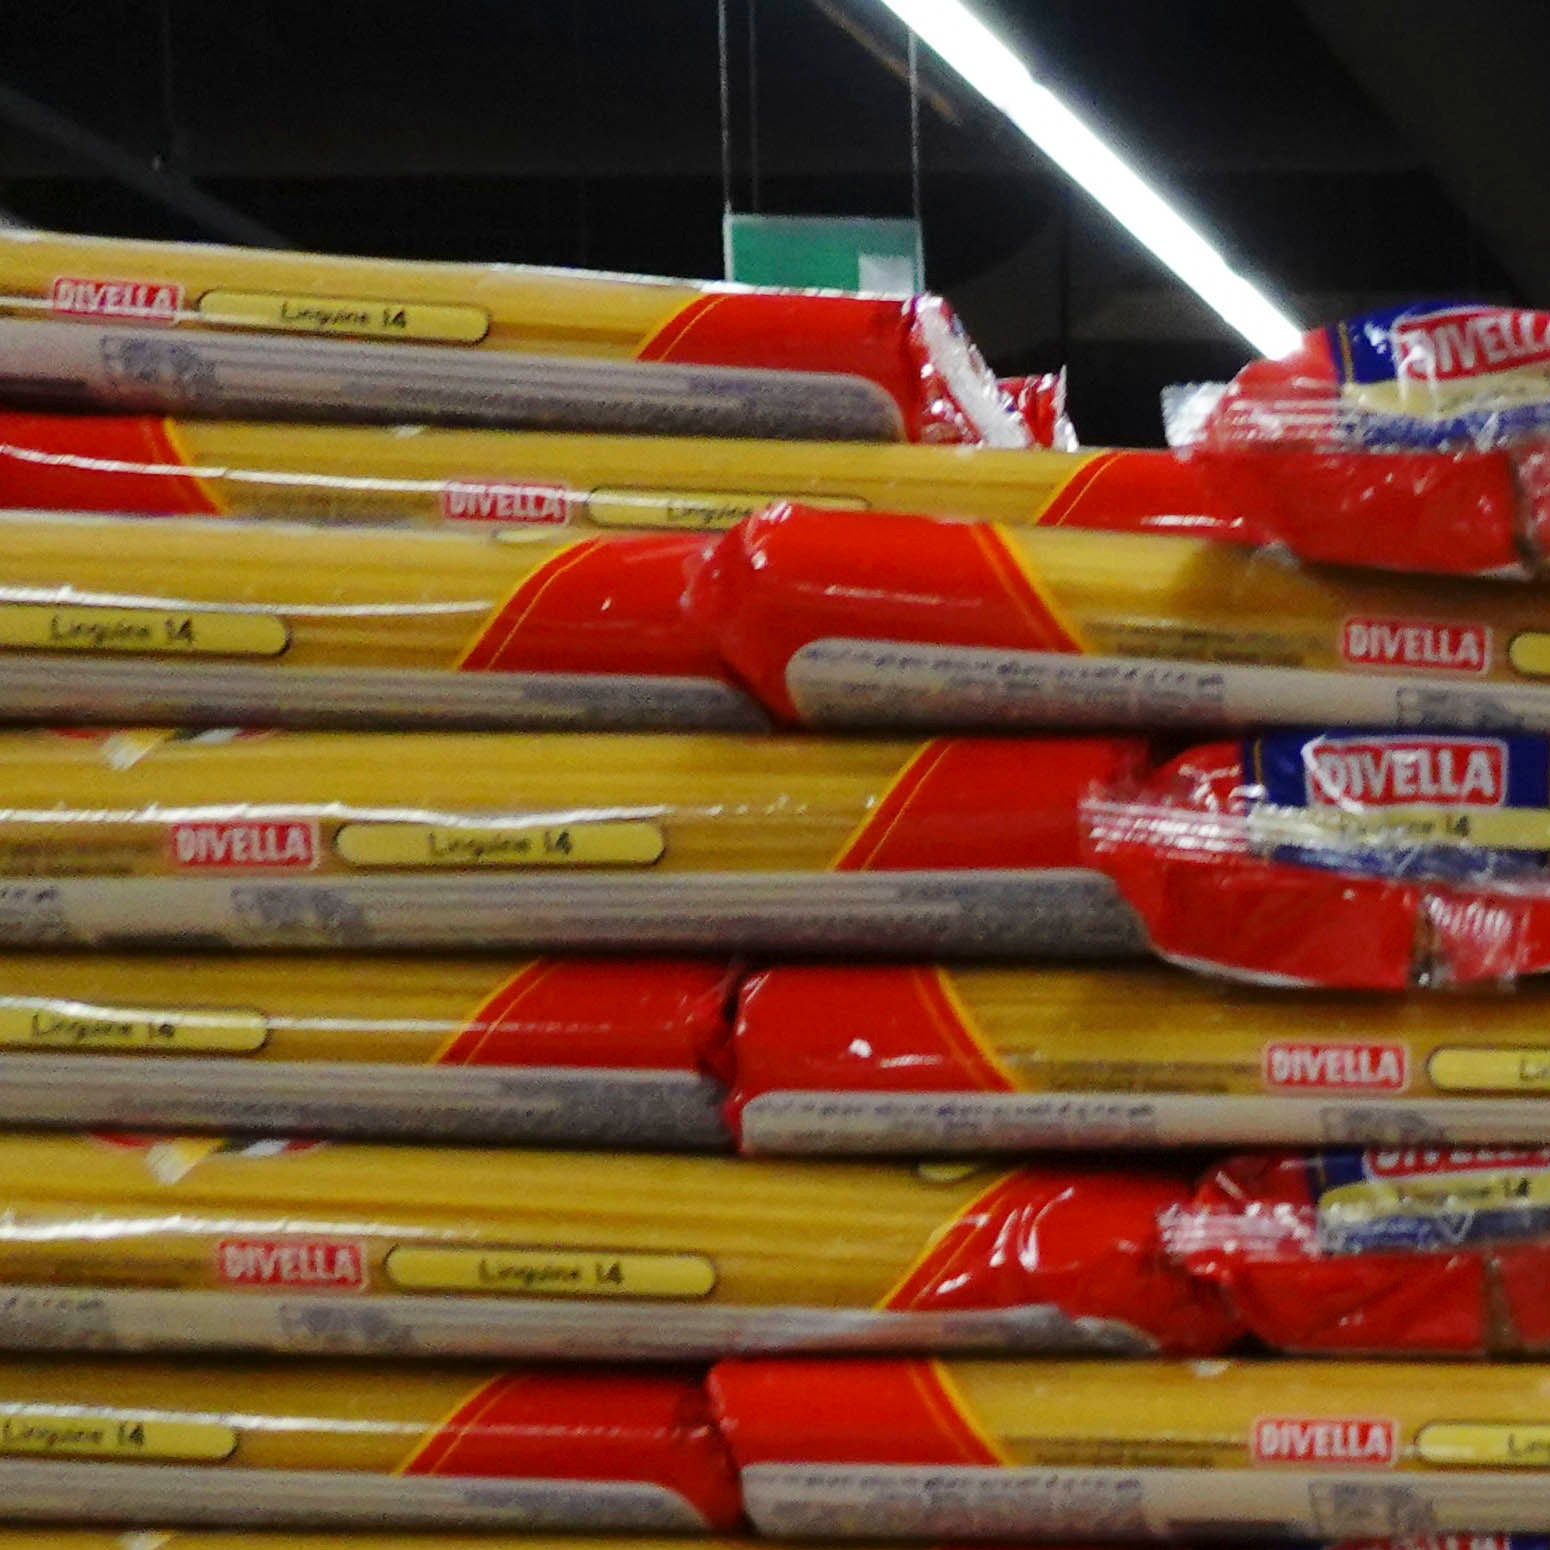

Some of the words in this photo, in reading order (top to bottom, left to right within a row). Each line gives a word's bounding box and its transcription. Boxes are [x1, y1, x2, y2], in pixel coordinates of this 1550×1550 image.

[57, 281, 179, 320] DIVELLA
[382, 309, 407, 330] 14
[448, 485, 563, 521] DIVELLA
[165, 618, 194, 642] 14
[1346, 625, 1480, 667] DIVELLA
[1314, 750, 1496, 798] DIVELLA
[174, 824, 307, 864] DIVELLA
[544, 831, 572, 855] 14
[1271, 1045, 1400, 1085] DIVELLA
[224, 1243, 356, 1284] DIVELLA
[595, 1256, 623, 1284] 14
[1261, 1421, 1394, 1460] DIVELLA
